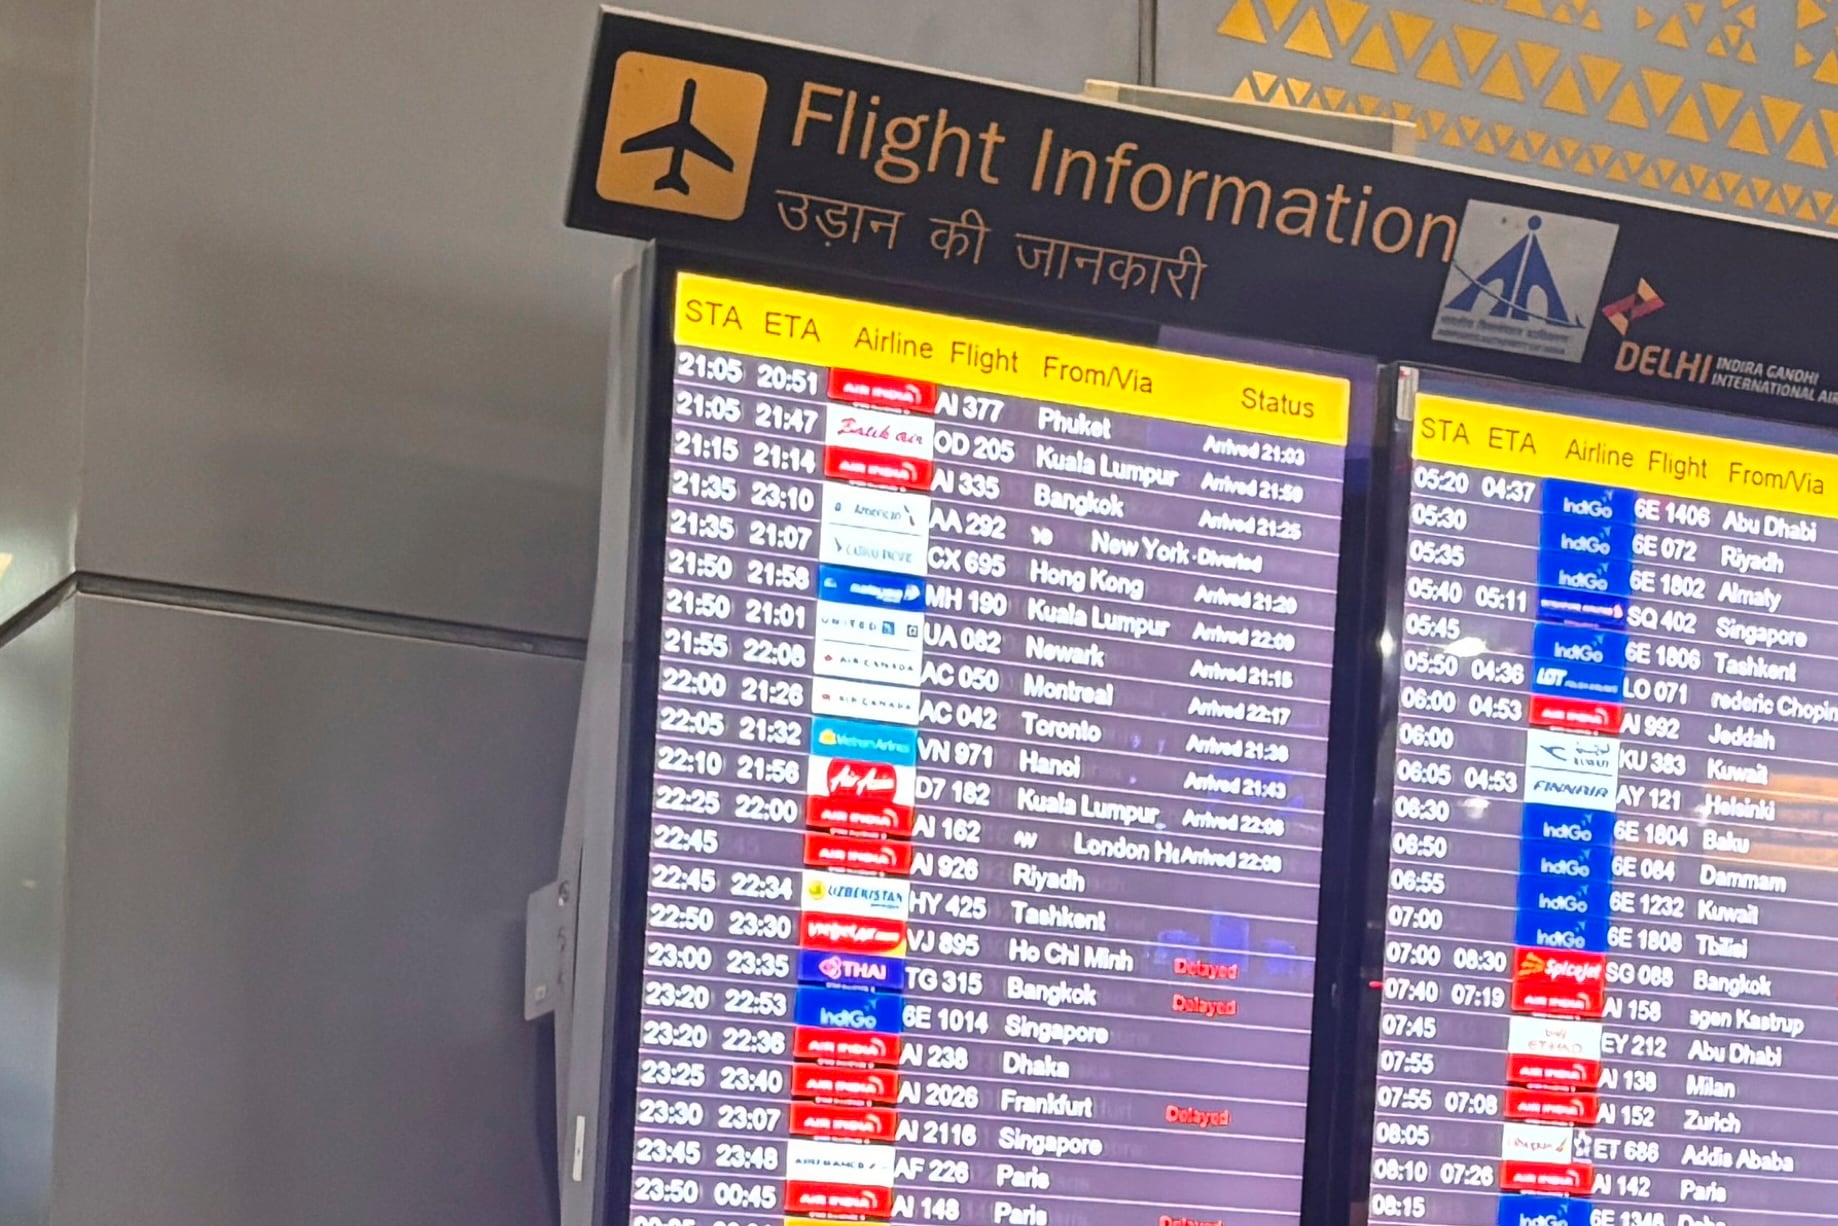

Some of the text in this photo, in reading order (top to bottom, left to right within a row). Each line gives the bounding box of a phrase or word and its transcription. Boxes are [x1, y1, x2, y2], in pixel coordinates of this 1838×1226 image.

[791, 80, 1457, 263] Flight Information
[774, 187, 1208, 302] उड़ान की जानकारी
[685, 298, 1314, 419] STA ETA Airline Flight From/Via Status
[1614, 340, 1821, 386] DELHI INDIRA GANDHI
[1711, 373, 1817, 403] INTERNATIONAL
[677, 351, 742, 382] 21:05
[757, 363, 817, 394] 20:51
[936, 391, 958, 416] AI
[962, 395, 1004, 422] 377
[1038, 406, 1110, 439] Phuket
[674, 430, 1123, 517] 21:15 21:14 AI 335 Bangkok
[675, 390, 740, 422] 21:05
[755, 402, 818, 433] 21:47
[934, 430, 969, 455] OD
[972, 435, 1014, 462] 205
[1036, 444, 1095, 475] Kuala
[1100, 453, 1179, 487] Lumpur
[1421, 416, 1469, 445] STA
[1487, 426, 1536, 455] ETA
[1564, 438, 1633, 469] Airline
[1647, 449, 1707, 482] Flight
[1728, 461, 1824, 496] From/Via
[672, 469, 736, 501] 21:35
[750, 481, 814, 511] 23:10
[929, 507, 962, 533] AA
[965, 512, 1006, 539] 292
[1090, 531, 1138, 556] New
[1141, 538, 1189, 564] York
[1411, 502, 1466, 530] 05:30
[1633, 533, 1657, 556] 6E
[1660, 537, 1697, 561] 072
[1720, 545, 1784, 573] Riyadh
[1413, 466, 1469, 493] 05:20
[1481, 475, 1535, 502] 04:37
[1635, 498, 1660, 520] 6E
[1665, 502, 1710, 527] 1406
[1722, 510, 1760, 534] Abu
[1763, 515, 1816, 542] Dhabi
[670, 508, 734, 540] 21:35
[749, 520, 812, 550] 21:07
[927, 545, 961, 571] CX
[964, 550, 1005, 577] 695
[1030, 558, 1085, 592] Hong
[1089, 567, 1143, 600] Kong
[666, 588, 1104, 667] 21:50 21:01 UA Newark
[1407, 576, 1462, 603] 05:40
[1474, 584, 1526, 612] 05:11
[1627, 605, 1657, 629] SQ
[1660, 609, 1696, 633] 402
[1715, 616, 1807, 647] Singapore
[1468, 694, 1775, 749] 04:53 AI 992 Jeddah
[1623, 677, 1650, 699] LO
[1653, 680, 1687, 704] 071
[660, 706, 1080, 778] 22:05 21:32 VN 971 Hanoi
[1615, 784, 1644, 806] AY
[1648, 787, 1680, 810] 121
[1707, 793, 1775, 820] Helsinki
[651, 863, 1105, 931] 22:45 22:34 HY 425 Tashkent
[1610, 891, 1758, 924] 6E 1232 Kuwait
[645, 981, 709, 1009] 23:20
[724, 988, 786, 1016] 22:53
[903, 1005, 931, 1028] 6E
[937, 1008, 988, 1033] 1014
[1004, 1014, 1108, 1045] Singapore
[647, 942, 711, 970] 23:00
[726, 949, 788, 977] 23:35
[841, 959, 887, 980] THAI
[905, 966, 937, 990] TG
[941, 970, 982, 994] 315
[1007, 975, 1096, 1006] Bangkok
[1171, 993, 1238, 1018] Delayed
[1383, 977, 1804, 1037] 07:40 Kastrup
[1693, 969, 1771, 997] Bangkok
[1381, 1013, 1781, 1066] 07:45 EY 212 Abu Dhabi
[640, 1059, 1091, 1117] 23:25 23:40 AI Frankfurt
[1376, 1085, 1740, 1133] 07:55 AI 152 Zurich
